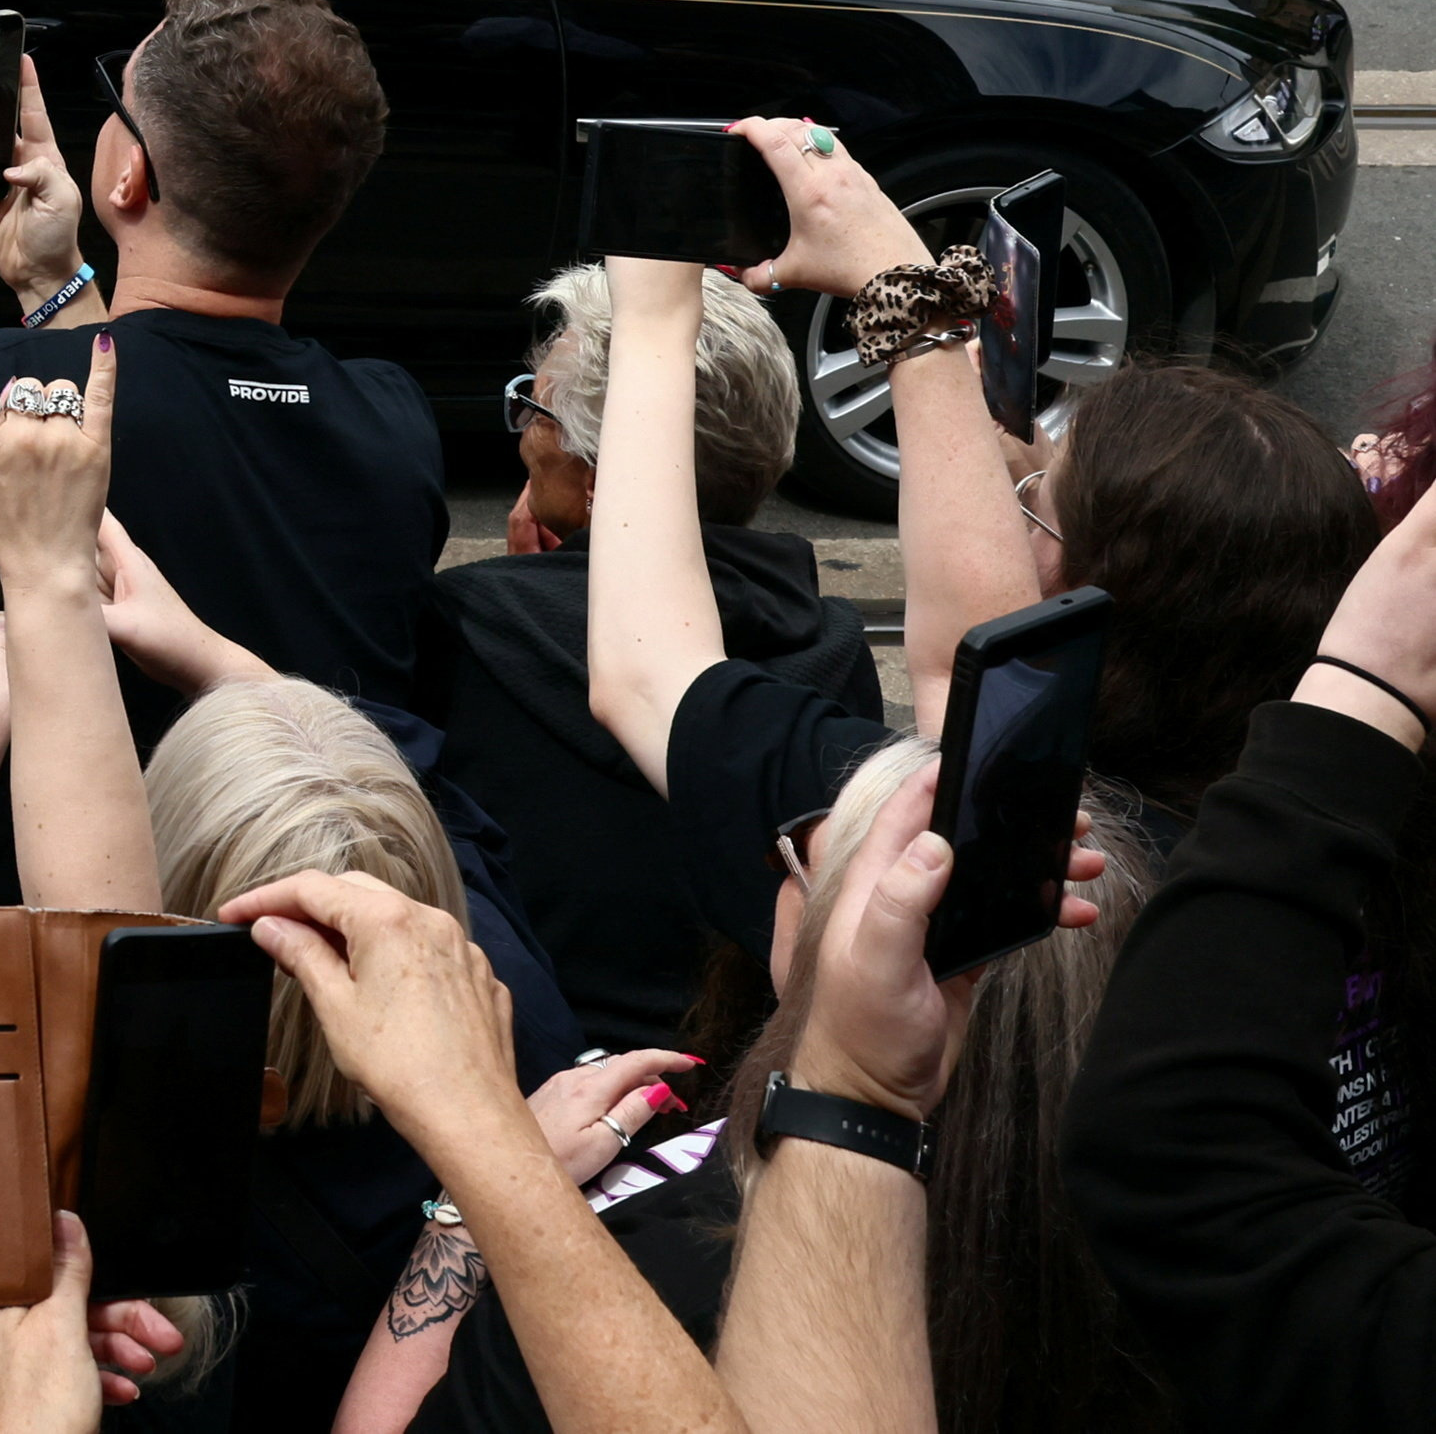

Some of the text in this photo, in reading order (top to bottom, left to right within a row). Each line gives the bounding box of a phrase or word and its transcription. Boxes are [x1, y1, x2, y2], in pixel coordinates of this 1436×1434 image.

[57, 276, 84, 306] HELP
[42, 299, 59, 318] for
[229, 384, 310, 404] PROVIDE
